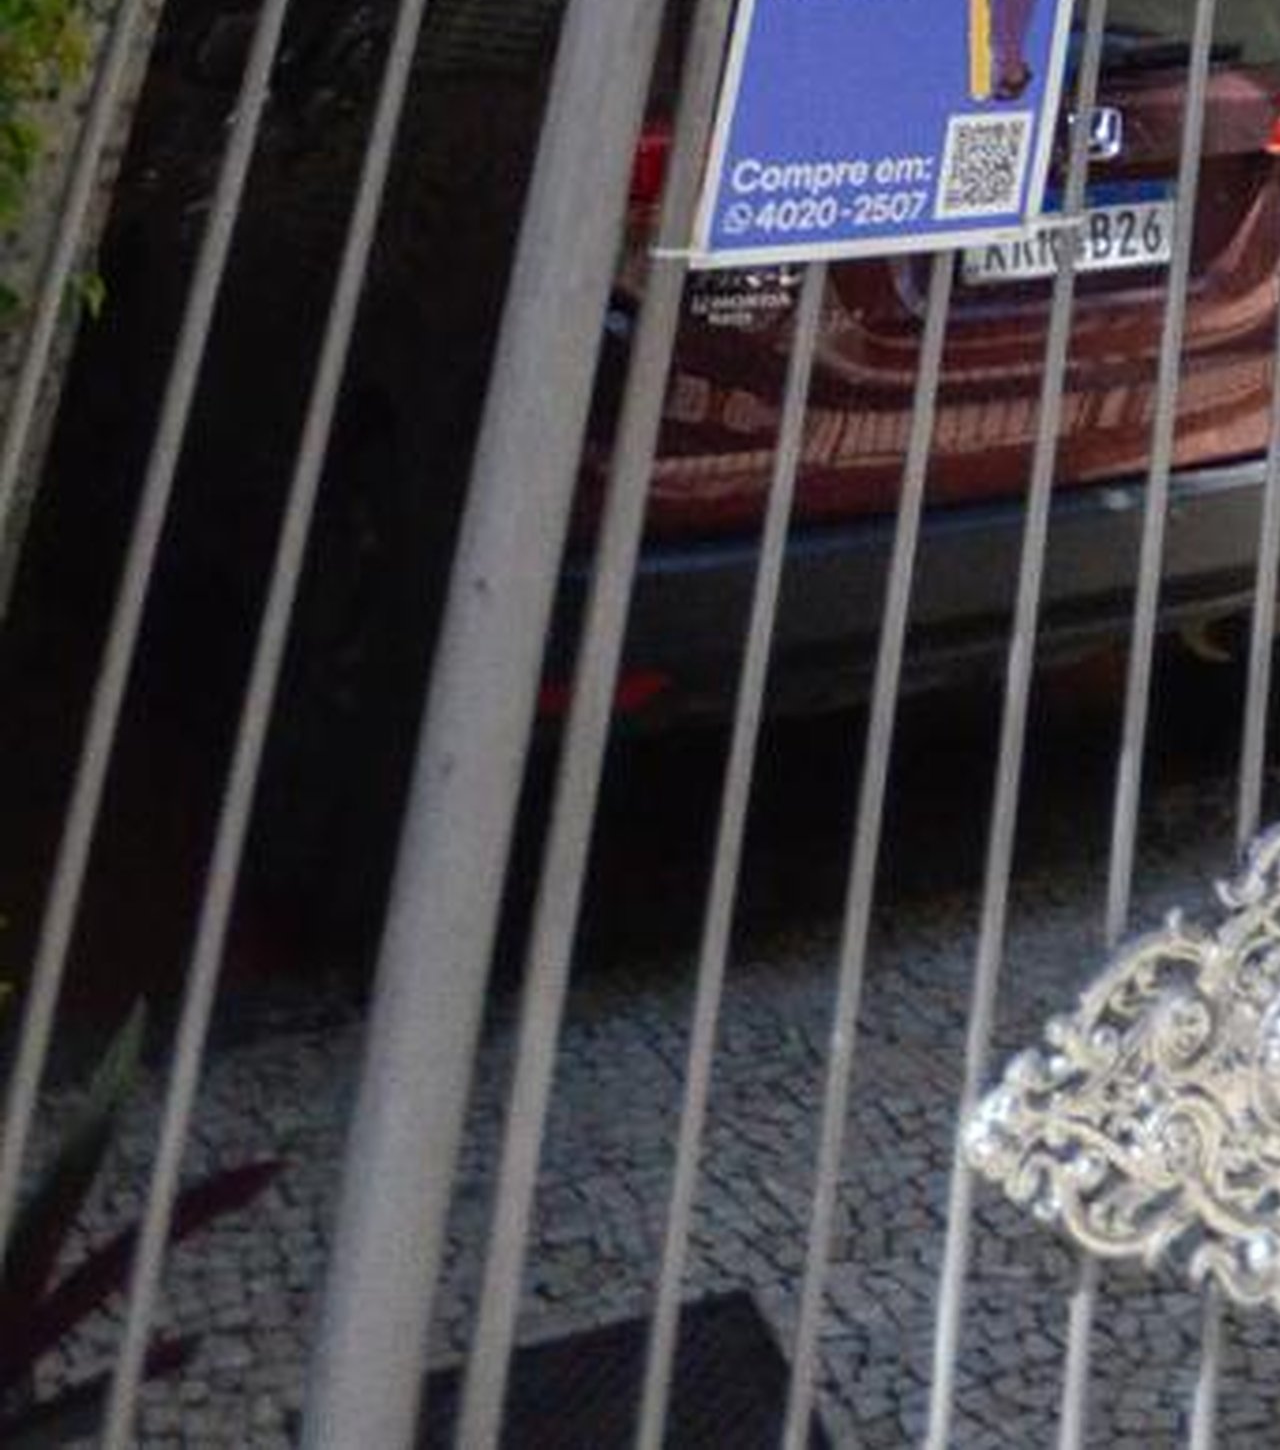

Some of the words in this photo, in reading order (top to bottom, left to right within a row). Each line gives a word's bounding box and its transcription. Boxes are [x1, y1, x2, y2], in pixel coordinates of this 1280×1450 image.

[731, 157, 870, 195] Compre
[874, 155, 935, 184] em:
[755, 191, 928, 232] 4020-2507
